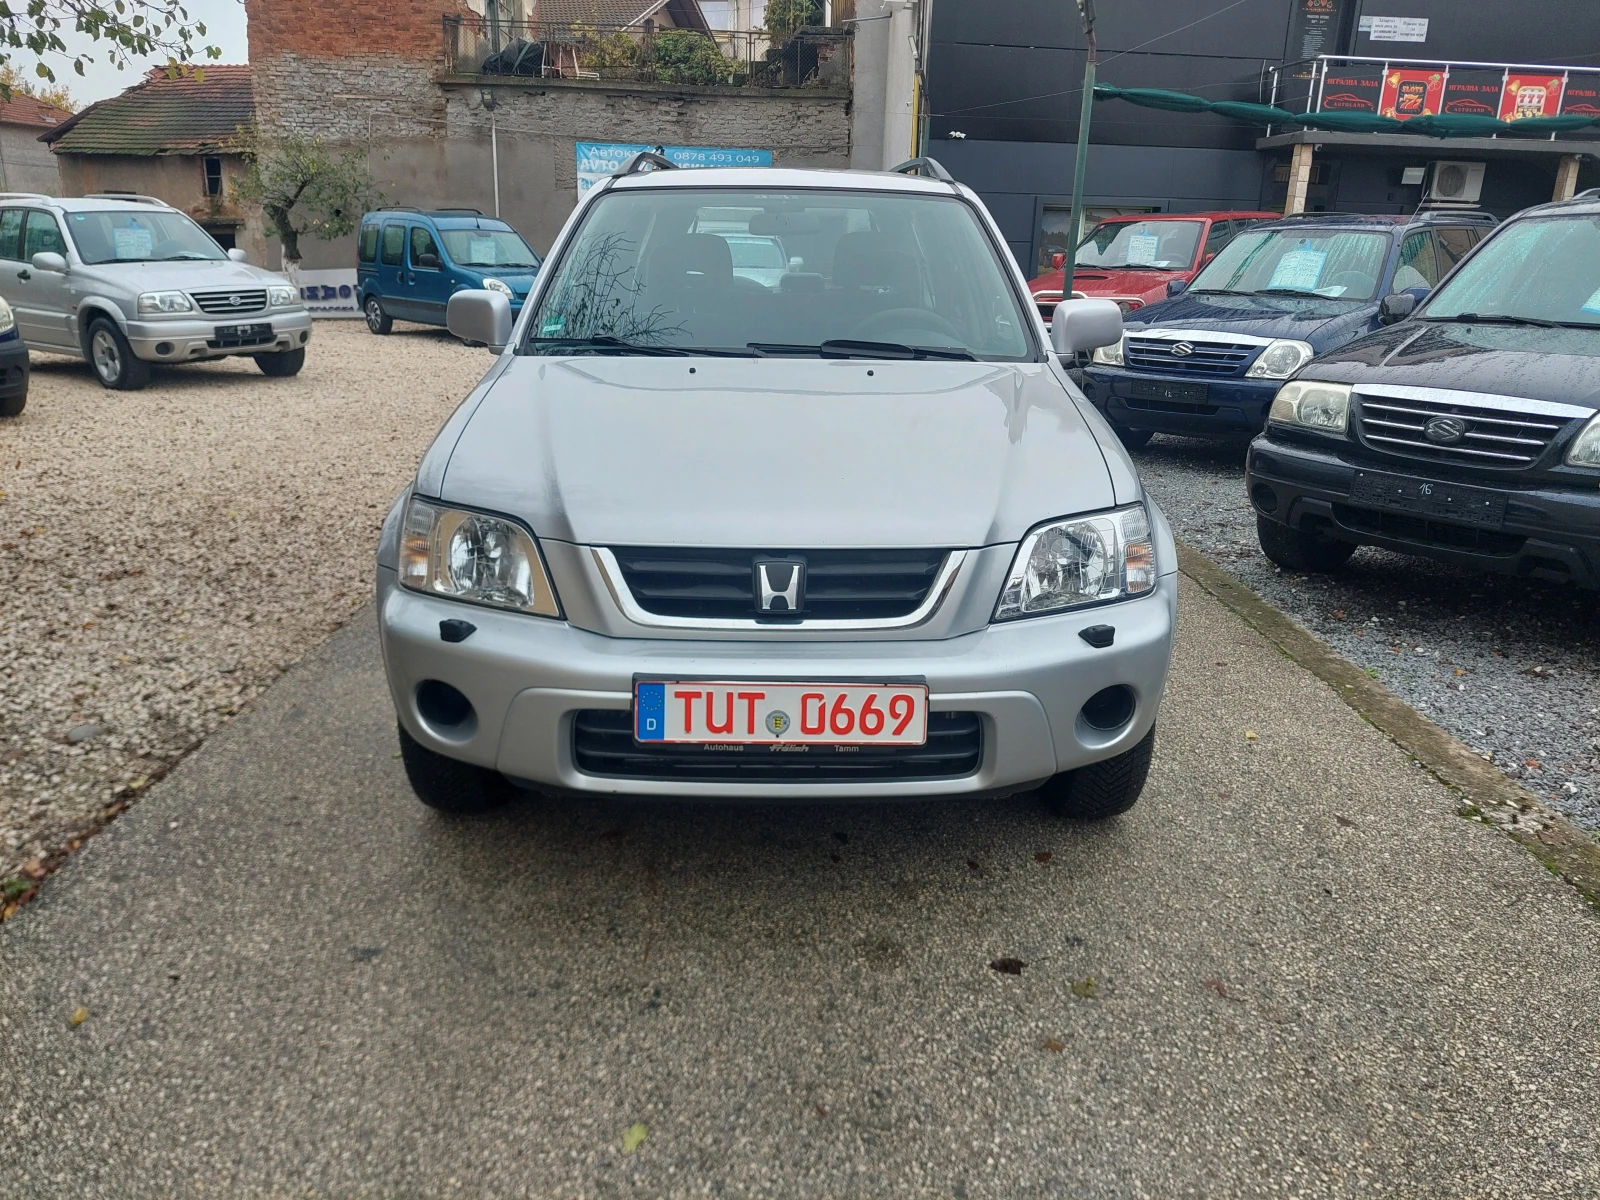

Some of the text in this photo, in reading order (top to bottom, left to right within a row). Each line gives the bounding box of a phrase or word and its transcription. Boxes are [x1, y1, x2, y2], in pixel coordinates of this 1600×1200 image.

[1401, 85, 1424, 93] SLOTS
[1399, 94, 1423, 109] 777
[673, 151, 706, 161] 0878
[709, 153, 732, 162] 493
[736, 154, 760, 163] 049
[580, 158, 619, 170] AVTO
[1419, 483, 1433, 494] 16
[674, 691, 915, 736] TUT 0669
[646, 718, 656, 730] D
[703, 743, 744, 752] Autohaus
[834, 745, 859, 753] Tamm
